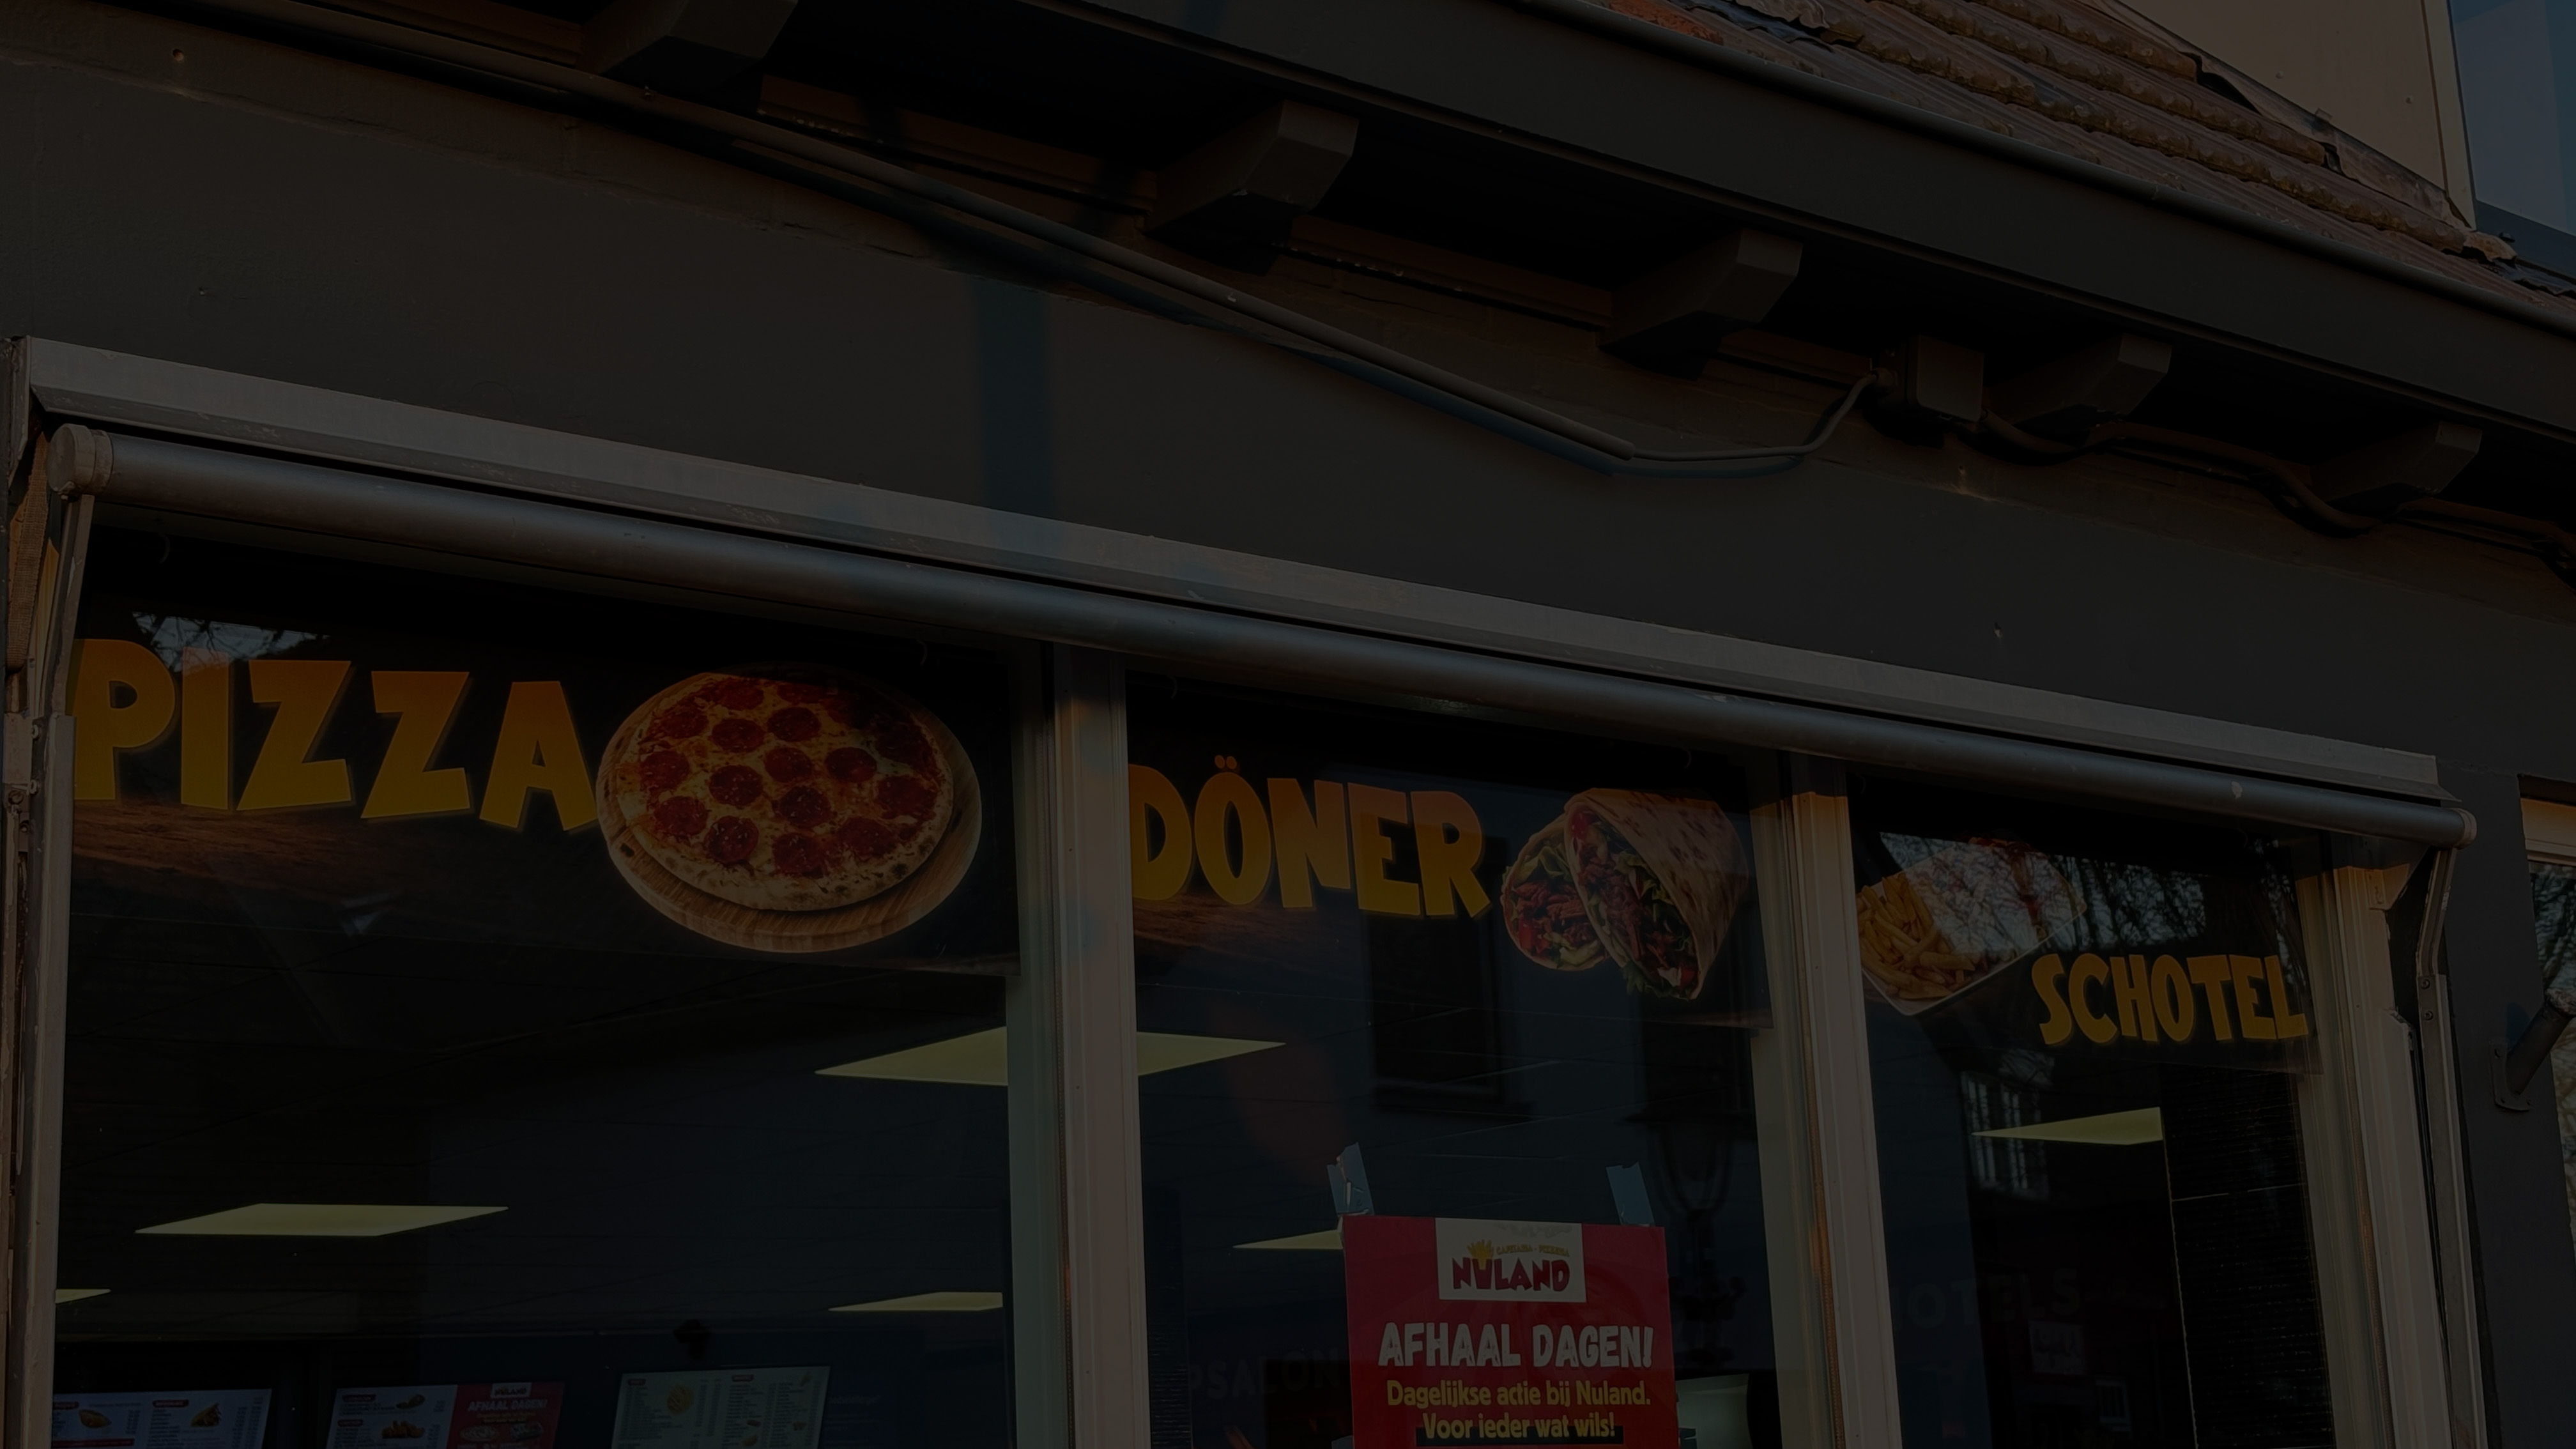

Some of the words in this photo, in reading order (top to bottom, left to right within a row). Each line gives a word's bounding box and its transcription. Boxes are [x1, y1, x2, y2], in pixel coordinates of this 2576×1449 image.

[73, 638, 601, 831] PIZZA
[1128, 753, 1491, 918] DÖNER
[2030, 952, 2310, 1046] SCHOTEL
[1452, 1257, 1570, 1292] NULAND
[1378, 1322, 1521, 1367] AFHAAL
[1533, 1324, 1654, 1368] DAGEN!
[1387, 1379, 1492, 1408] Dagelijkse
[1497, 1381, 1542, 1406] actie
[1546, 1381, 1571, 1407] bij
[1575, 1380, 1652, 1406] Nuland.
[1422, 1412, 1473, 1439] Voor
[1478, 1413, 1531, 1438] ieder
[1535, 1414, 1570, 1438] wat
[1574, 1411, 1616, 1438] wils!
